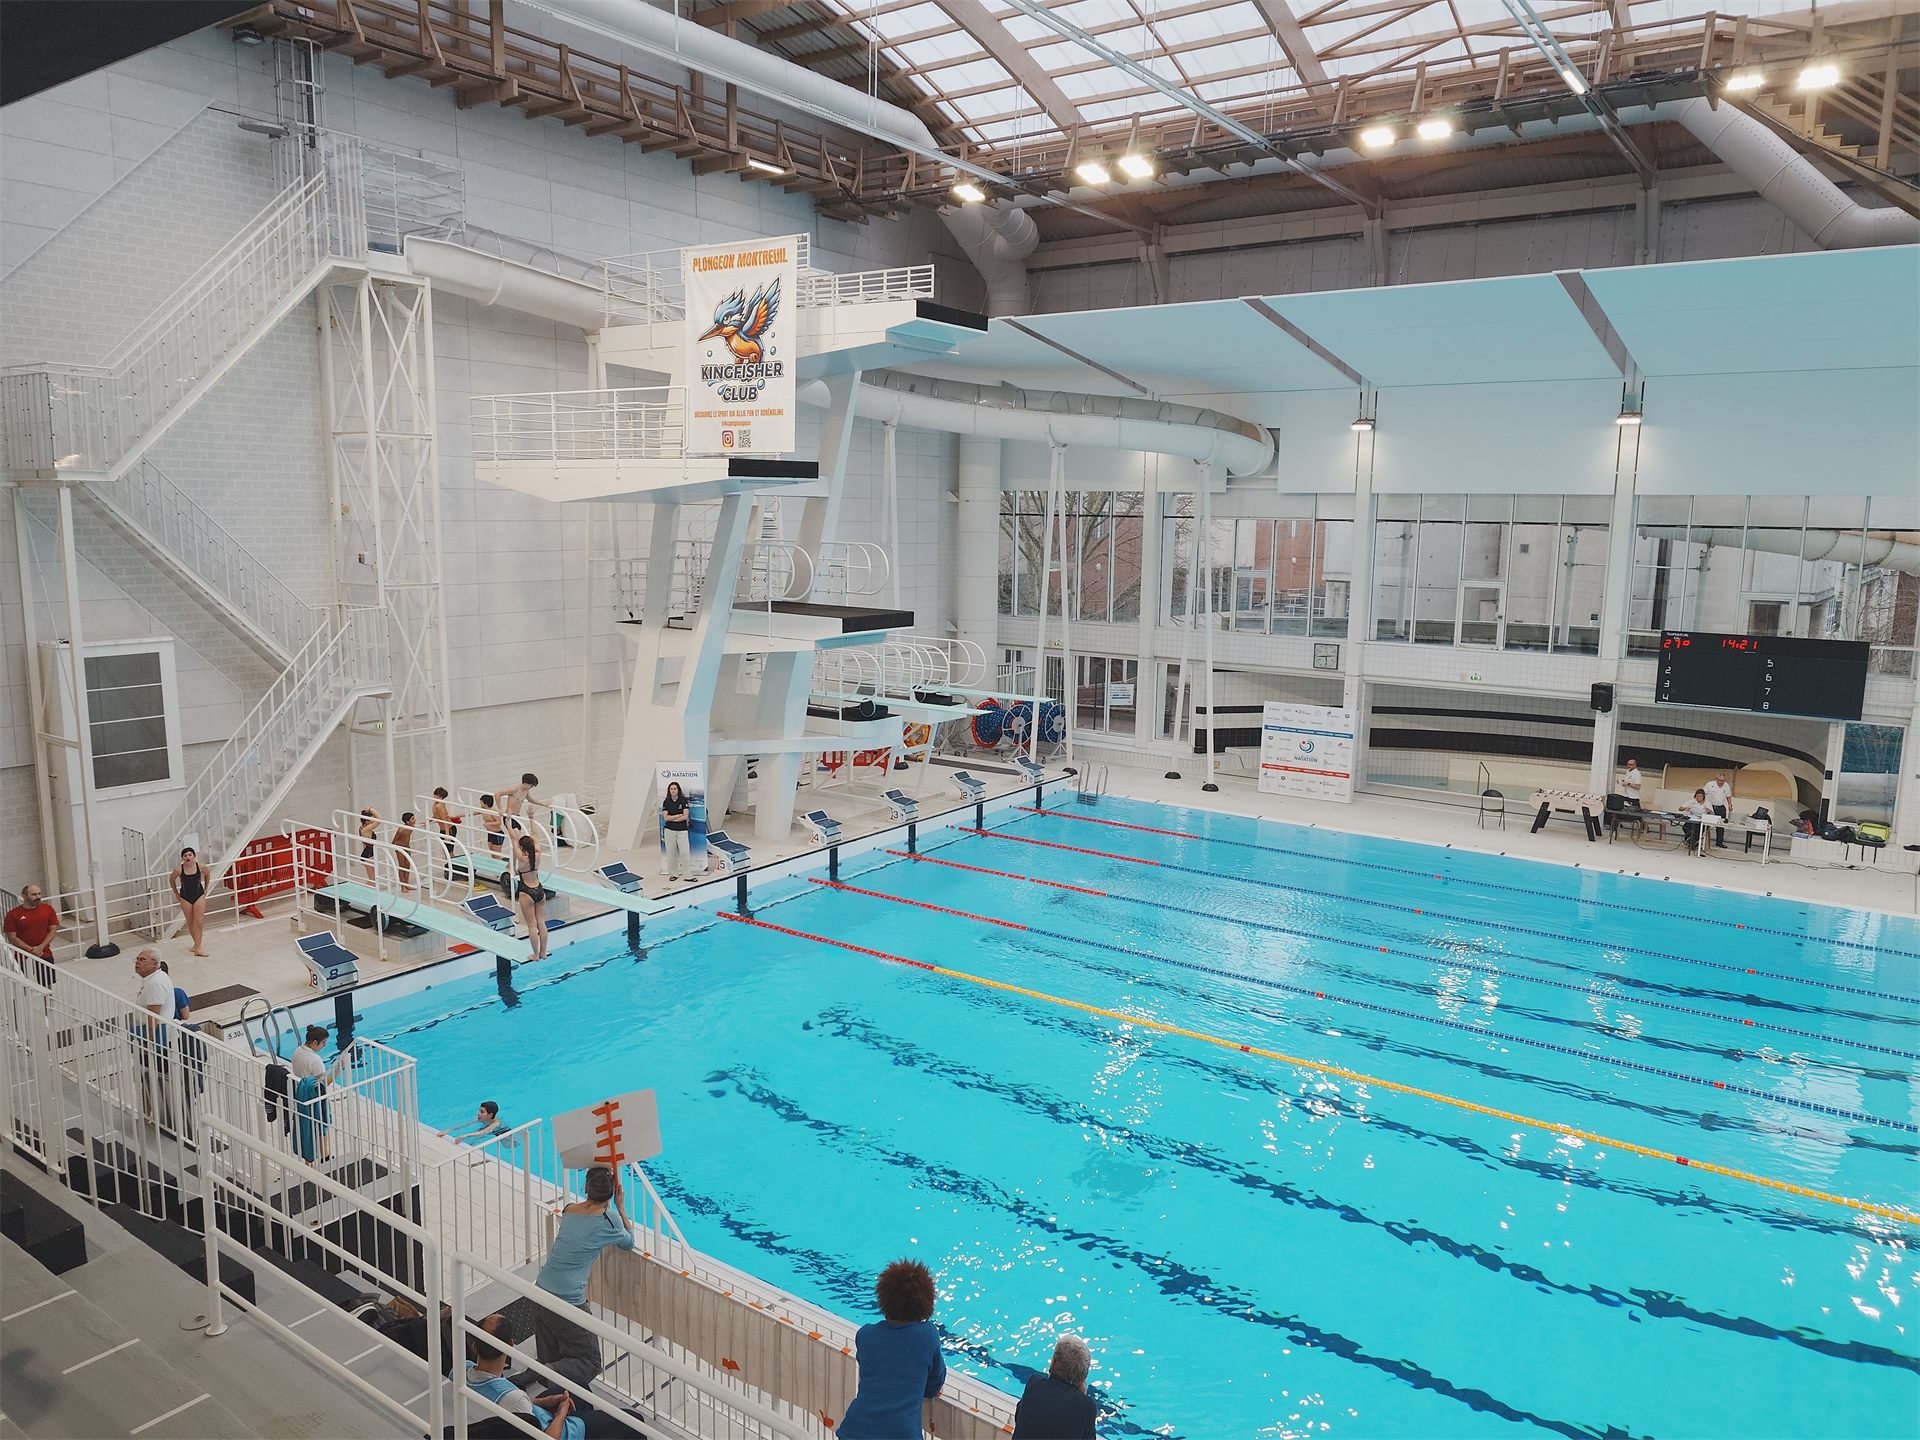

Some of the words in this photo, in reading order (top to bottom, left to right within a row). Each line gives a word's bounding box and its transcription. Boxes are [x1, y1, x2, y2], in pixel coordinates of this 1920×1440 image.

[693, 254, 735, 272] PLONGEON
[737, 248, 788, 268] MONTREUIL
[701, 362, 783, 380] KINGFISHER
[723, 386, 757, 401] CLUB
[1722, 639, 1758, 650] 14:21
[1767, 659, 1774, 667] 5
[1665, 666, 1672, 674] 2
[1664, 680, 1670, 688] 3
[1764, 687, 1771, 695] 7
[1662, 693, 1669, 701] 4
[1763, 702, 1769, 710] 8
[963, 791, 967, 799] 2
[894, 810, 899, 818] 3
[720, 860, 725, 869] 5
[313, 974, 318, 985] 8
[330, 969, 339, 979] 8
